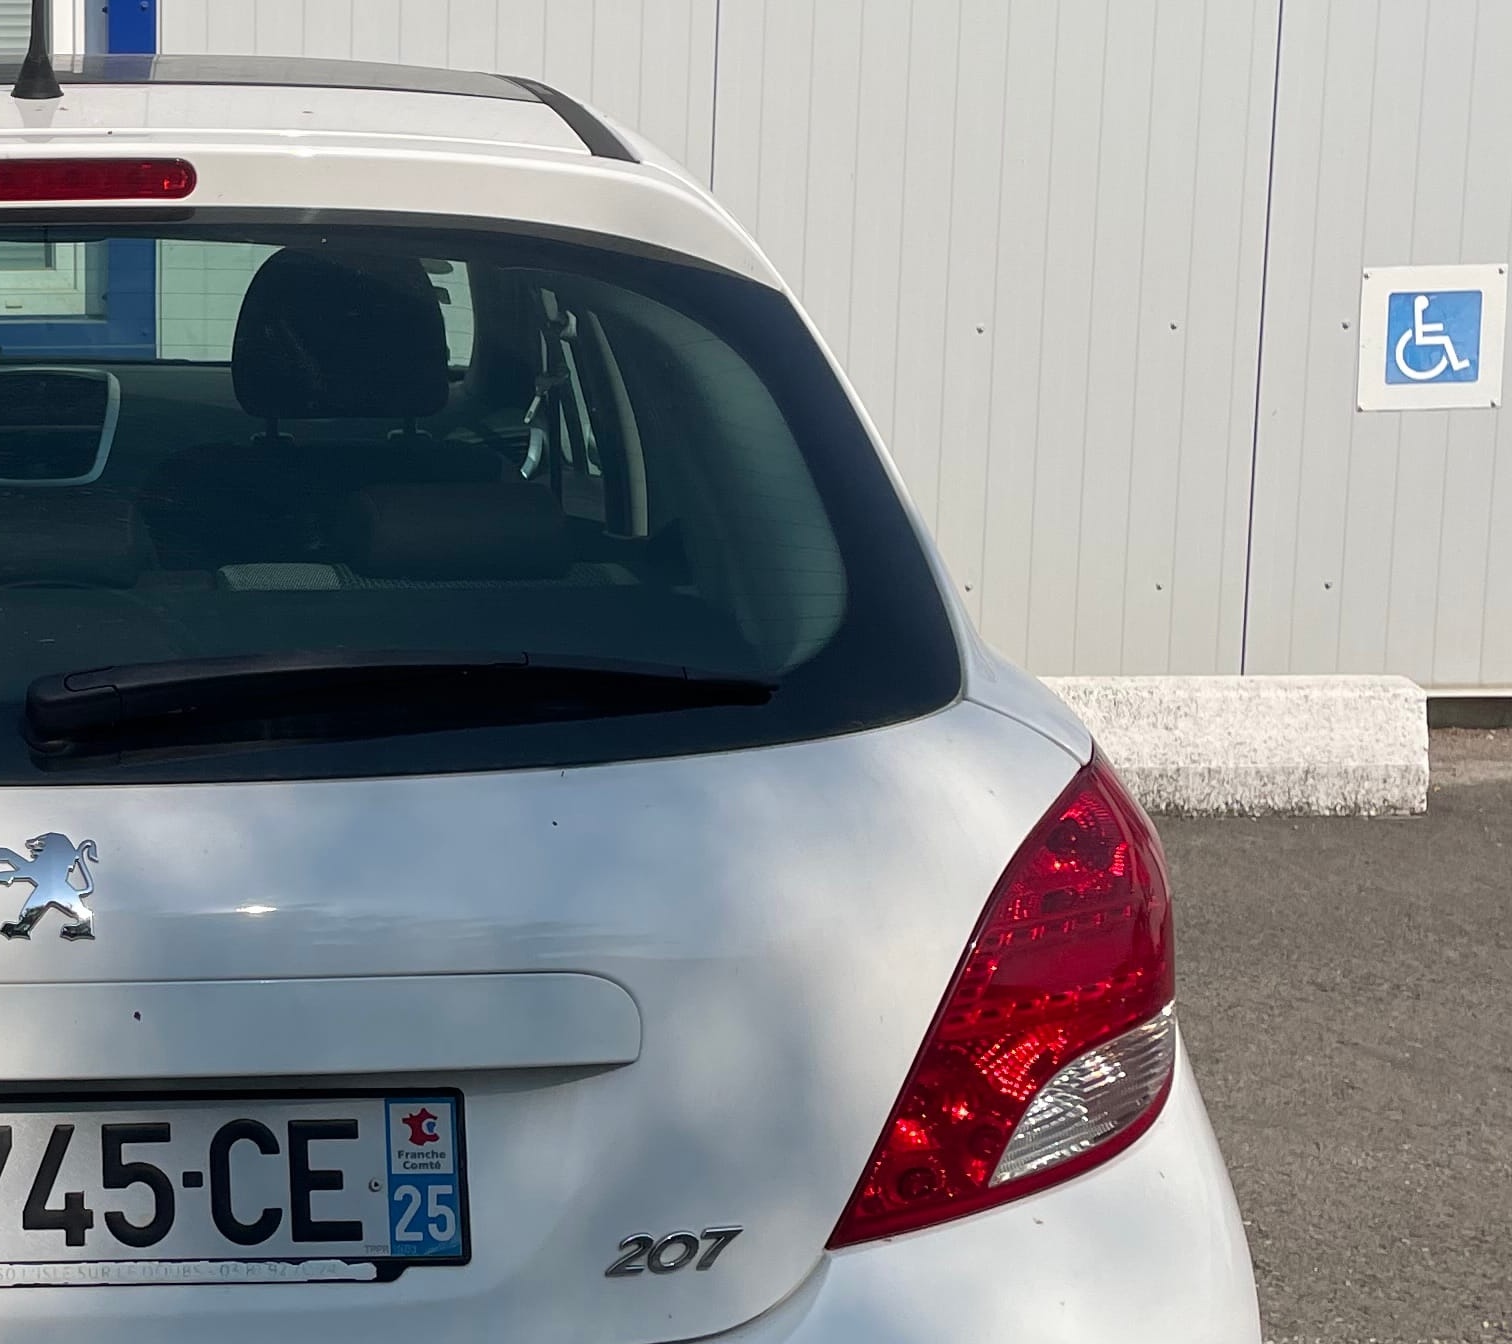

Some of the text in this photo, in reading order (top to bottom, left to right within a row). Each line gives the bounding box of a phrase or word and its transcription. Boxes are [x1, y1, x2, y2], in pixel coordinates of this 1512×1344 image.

[397, 1149, 446, 1160] Franche
[402, 1159, 442, 1170] Comté
[393, 1184, 456, 1242] 25
[604, 1224, 745, 1278] 207
